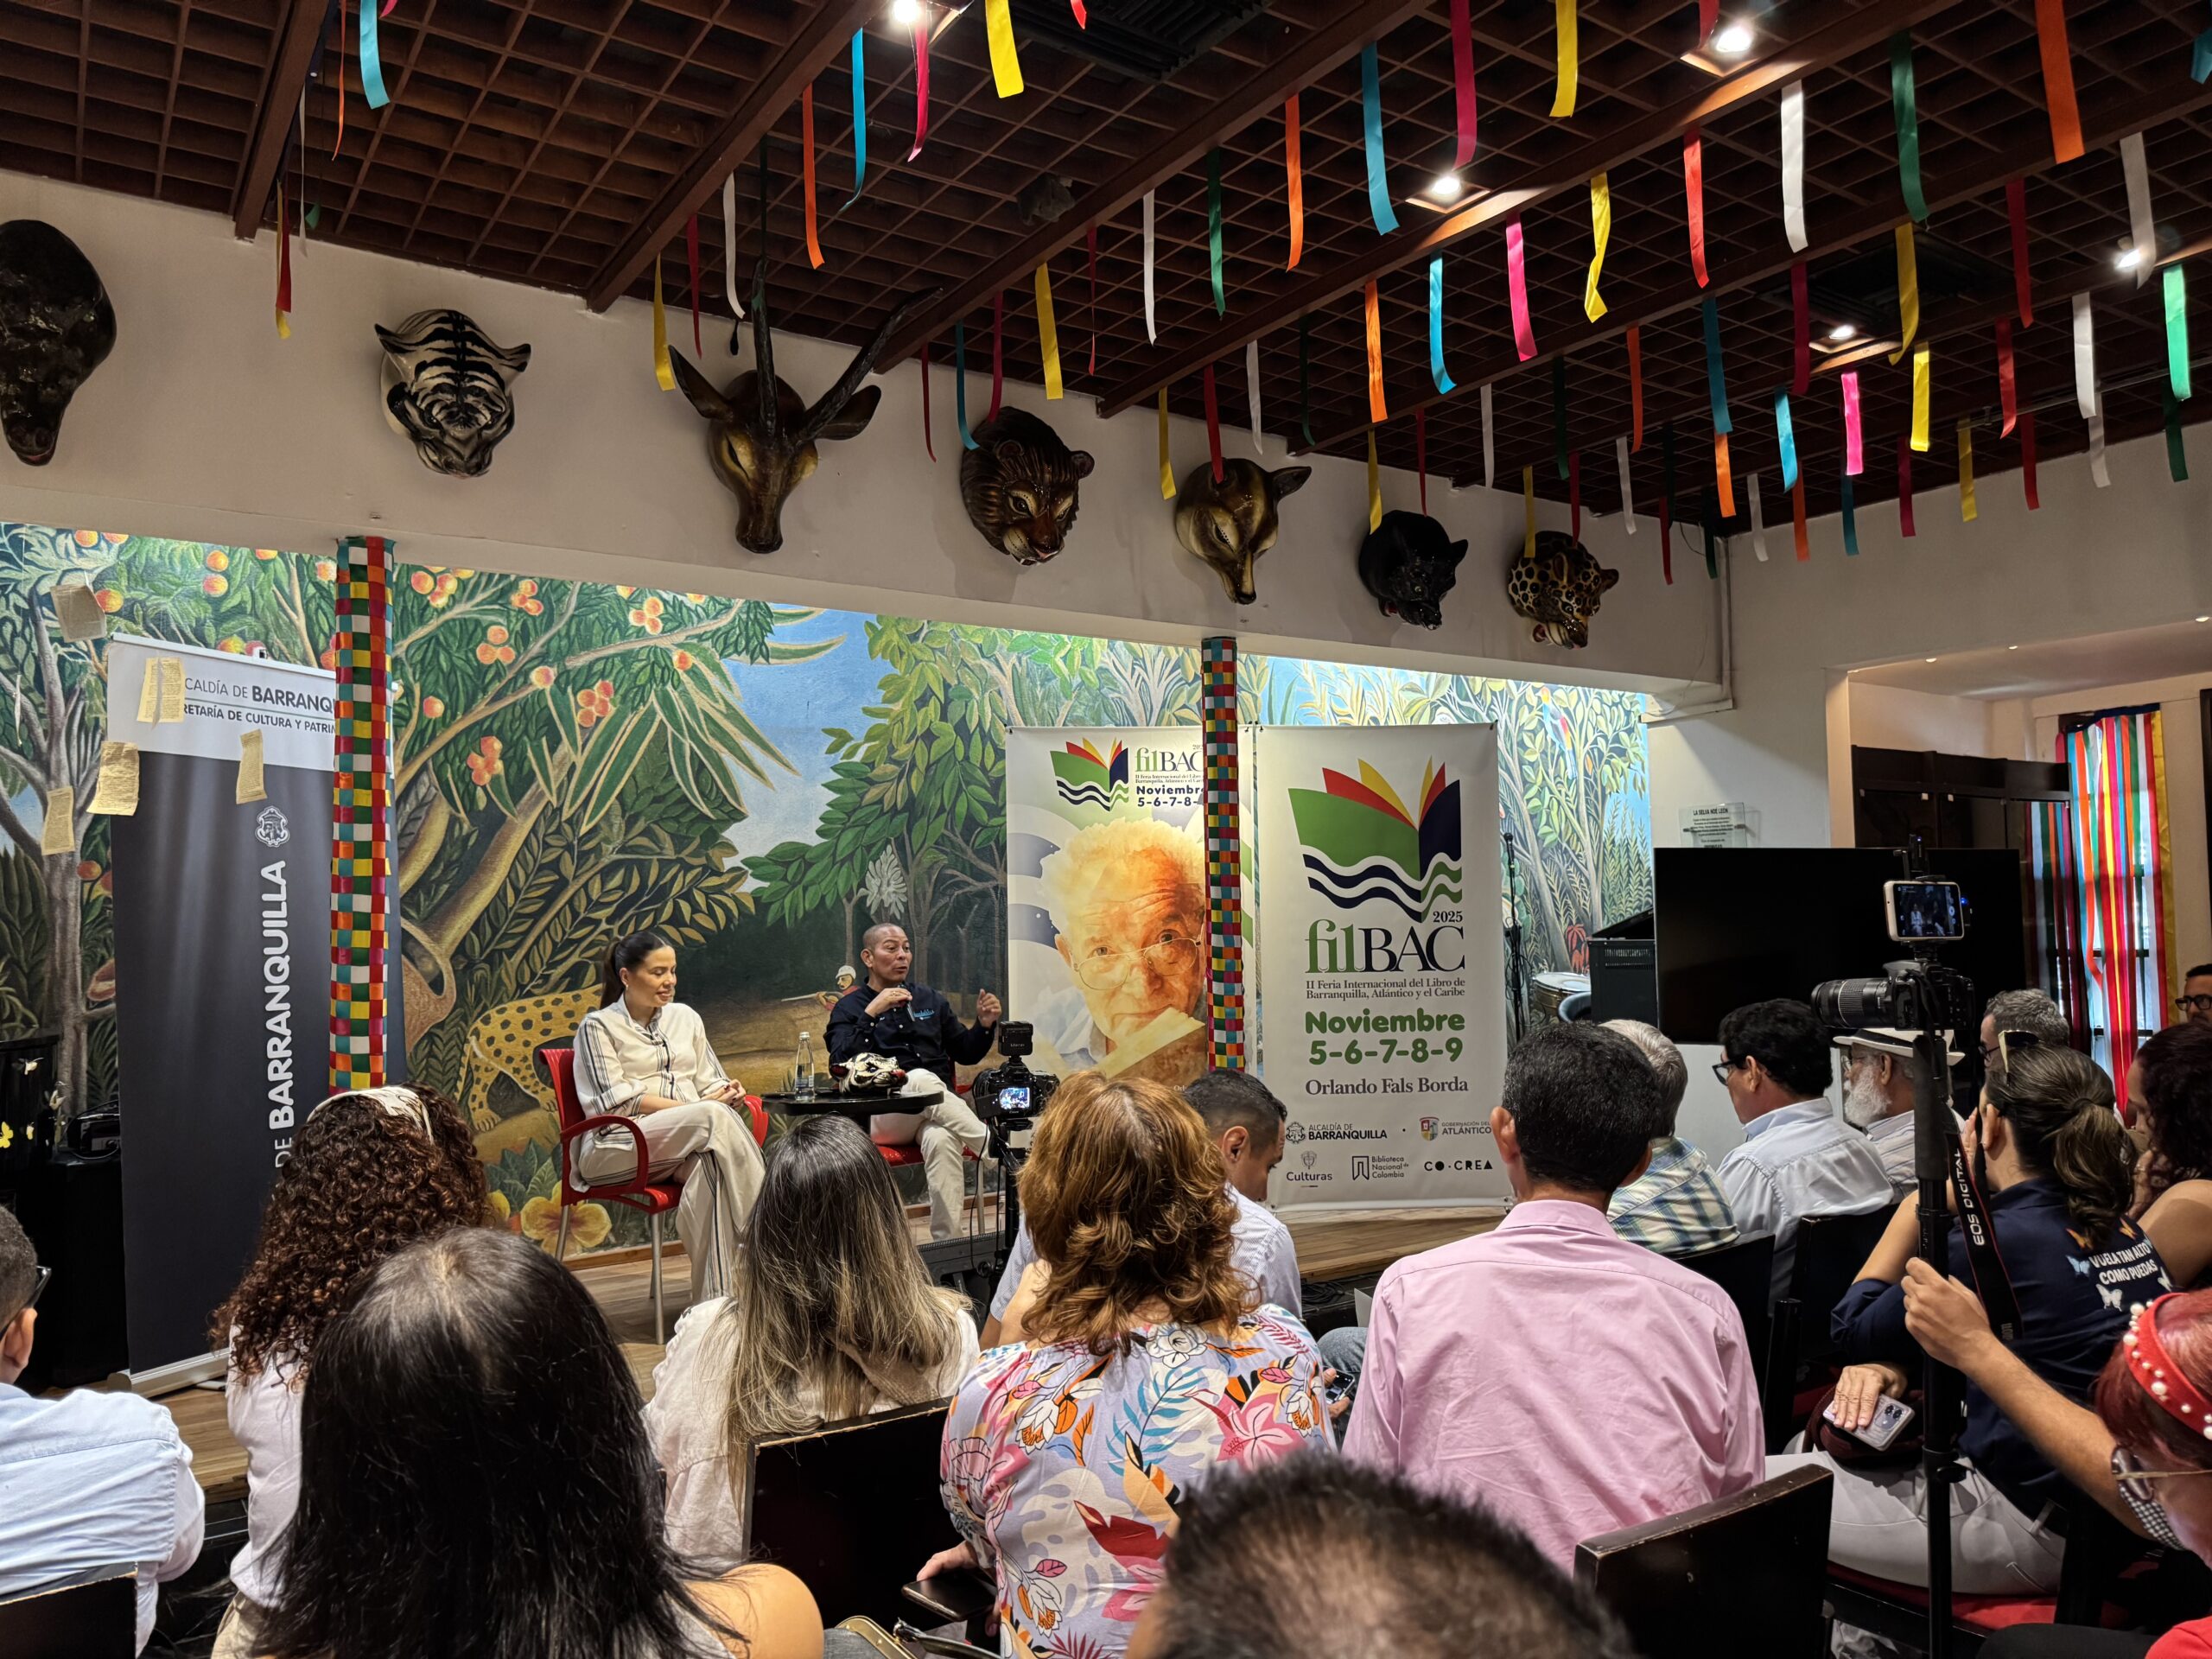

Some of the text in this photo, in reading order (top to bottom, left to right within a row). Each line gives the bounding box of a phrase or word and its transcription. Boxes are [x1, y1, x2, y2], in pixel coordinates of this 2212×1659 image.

[184, 677, 335, 714] CALDÍA DE BARRANQ
[183, 702, 225, 720] RETARÍA
[227, 709, 242, 721] DE
[245, 712, 292, 728] CULTURA
[295, 719, 302, 730] Y
[1433, 910, 1463, 923] 2025
[1305, 918, 1465, 974] filBAC
[1306, 976, 1465, 989] II Feria Internacional del Libro de
[1306, 987, 1465, 1001] Barranquilla, Atlántico y el Caribe
[260, 860, 295, 1168] DE BARRANQUILLA
[1305, 1007, 1465, 1034] Noviembre
[1309, 1037, 1463, 1065] 5-6-7-8-9
[1306, 1076, 1469, 1095] Orlando Fals Borda
[1308, 1129, 1388, 1141] BARRANQUILLA
[1309, 1122, 1342, 1131] ALCALDÍA
[1441, 1126, 1492, 1135] ATLÁNTICO
[1372, 1162, 1403, 1171] Nacional
[1372, 1170, 1404, 1179] Colombia
[1286, 1171, 1332, 1182] Culturas
[1954, 1147, 1986, 1246] EOS DIGITAL
[2088, 1242, 2152, 1268] VUELA TAN ALTO
[2099, 1258, 2158, 1286] COMO PUEDAS
